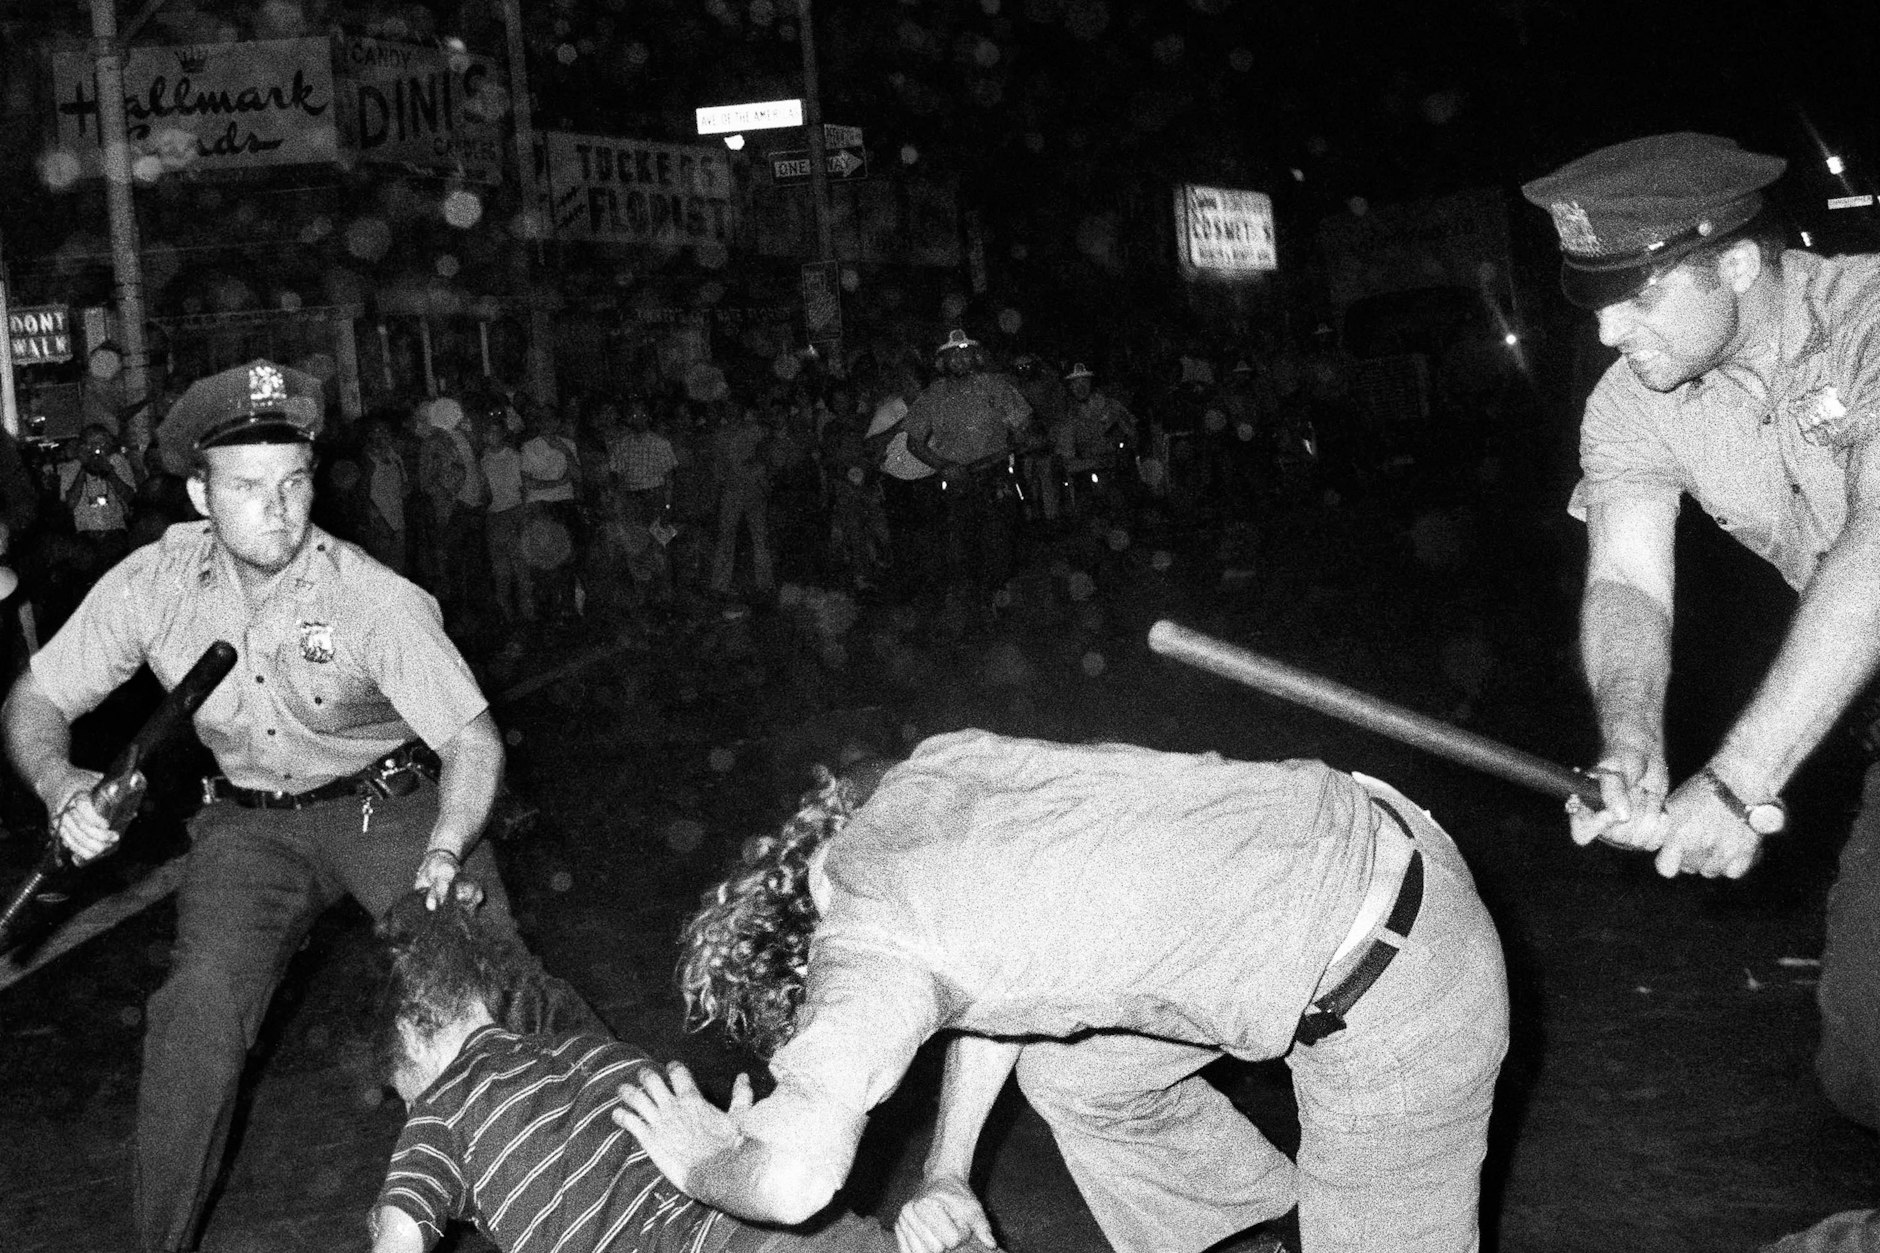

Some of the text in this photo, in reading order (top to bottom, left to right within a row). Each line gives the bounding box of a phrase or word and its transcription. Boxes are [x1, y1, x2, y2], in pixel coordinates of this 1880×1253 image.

[58, 69, 328, 142] Hallmark
[721, 112, 731, 124] OF
[734, 111, 750, 123] THE
[753, 107, 799, 121] AMERAS
[126, 121, 282, 157] Cds
[778, 159, 807, 176] ONE
[1192, 213, 1272, 243] COSMETS
[9, 311, 63, 335] DONT
[12, 335, 67, 358] WALK
